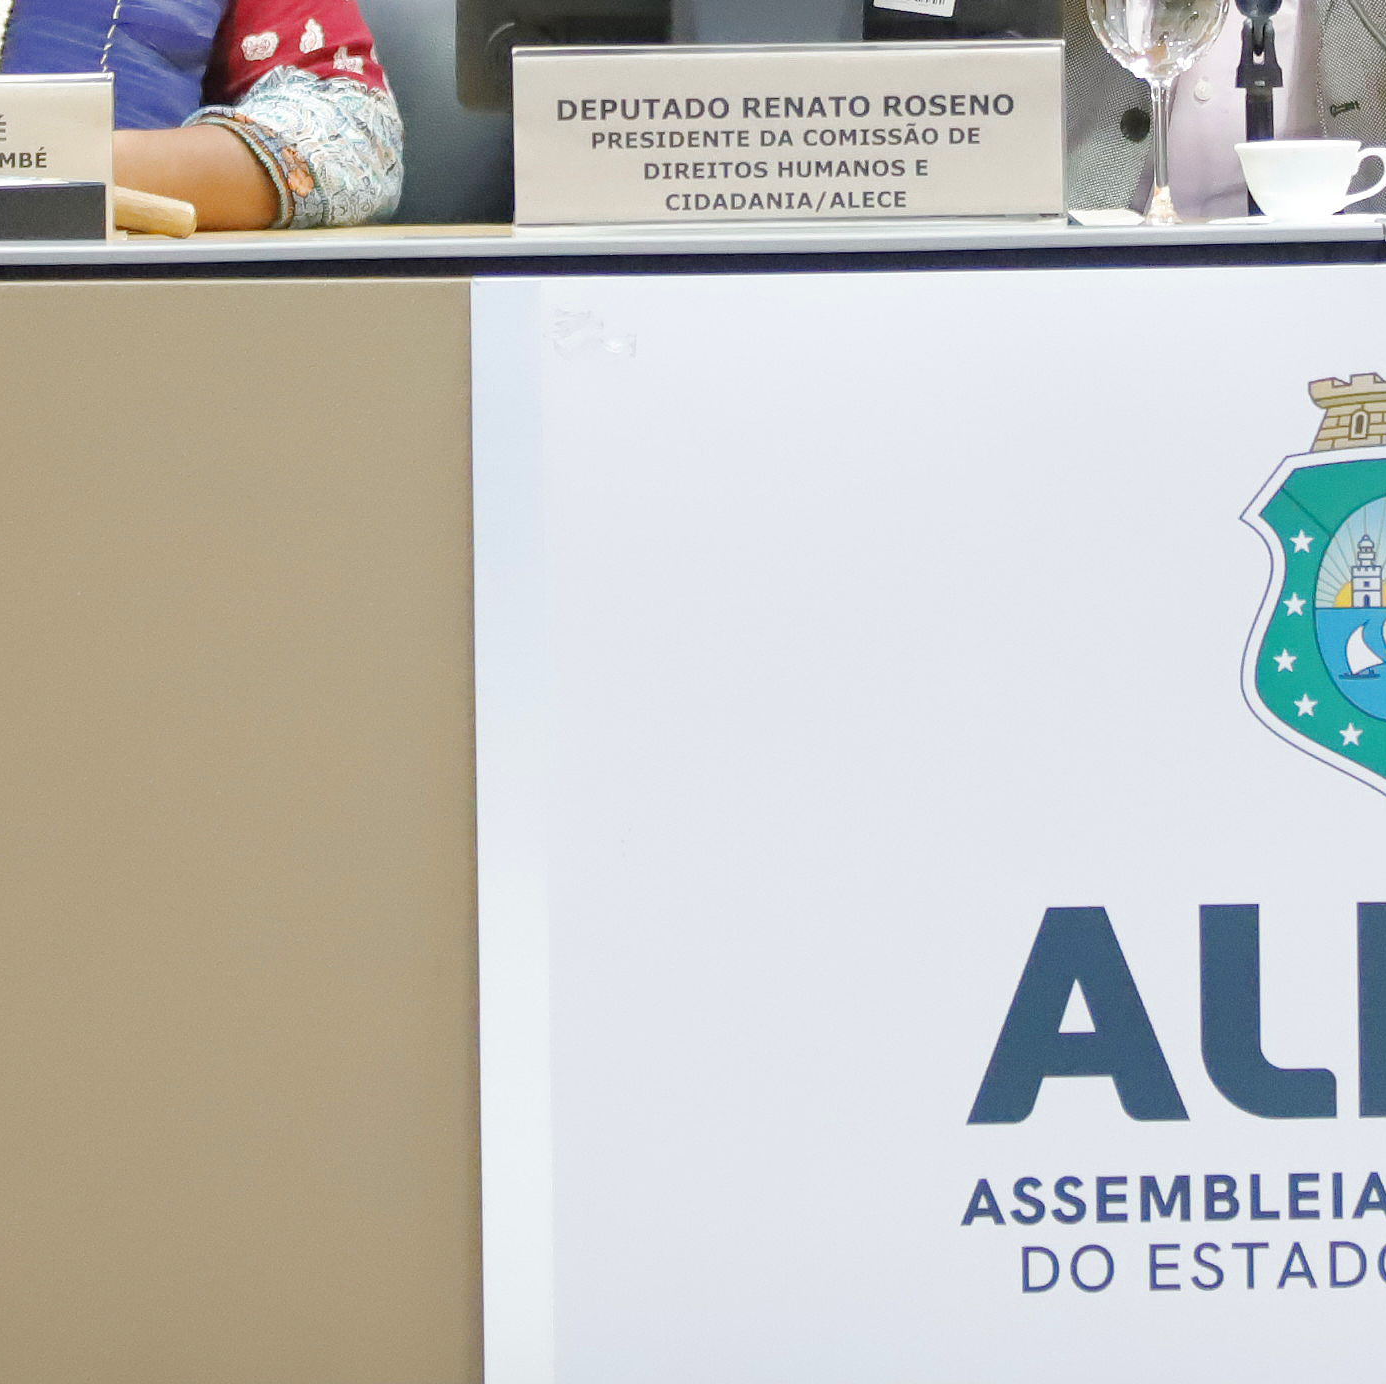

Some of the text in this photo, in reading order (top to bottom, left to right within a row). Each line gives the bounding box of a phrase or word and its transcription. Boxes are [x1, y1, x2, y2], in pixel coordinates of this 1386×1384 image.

[557, 93, 1014, 121] DEPUTADO RENATO ROSENO
[591, 122, 981, 149] PRESIDENTE DA COMISSÃO DE
[643, 159, 928, 180] DIREITOS HUMANOS E
[665, 190, 907, 213] CIDADANIA/ALECE
[1021, 1243, 1115, 1294] DO
